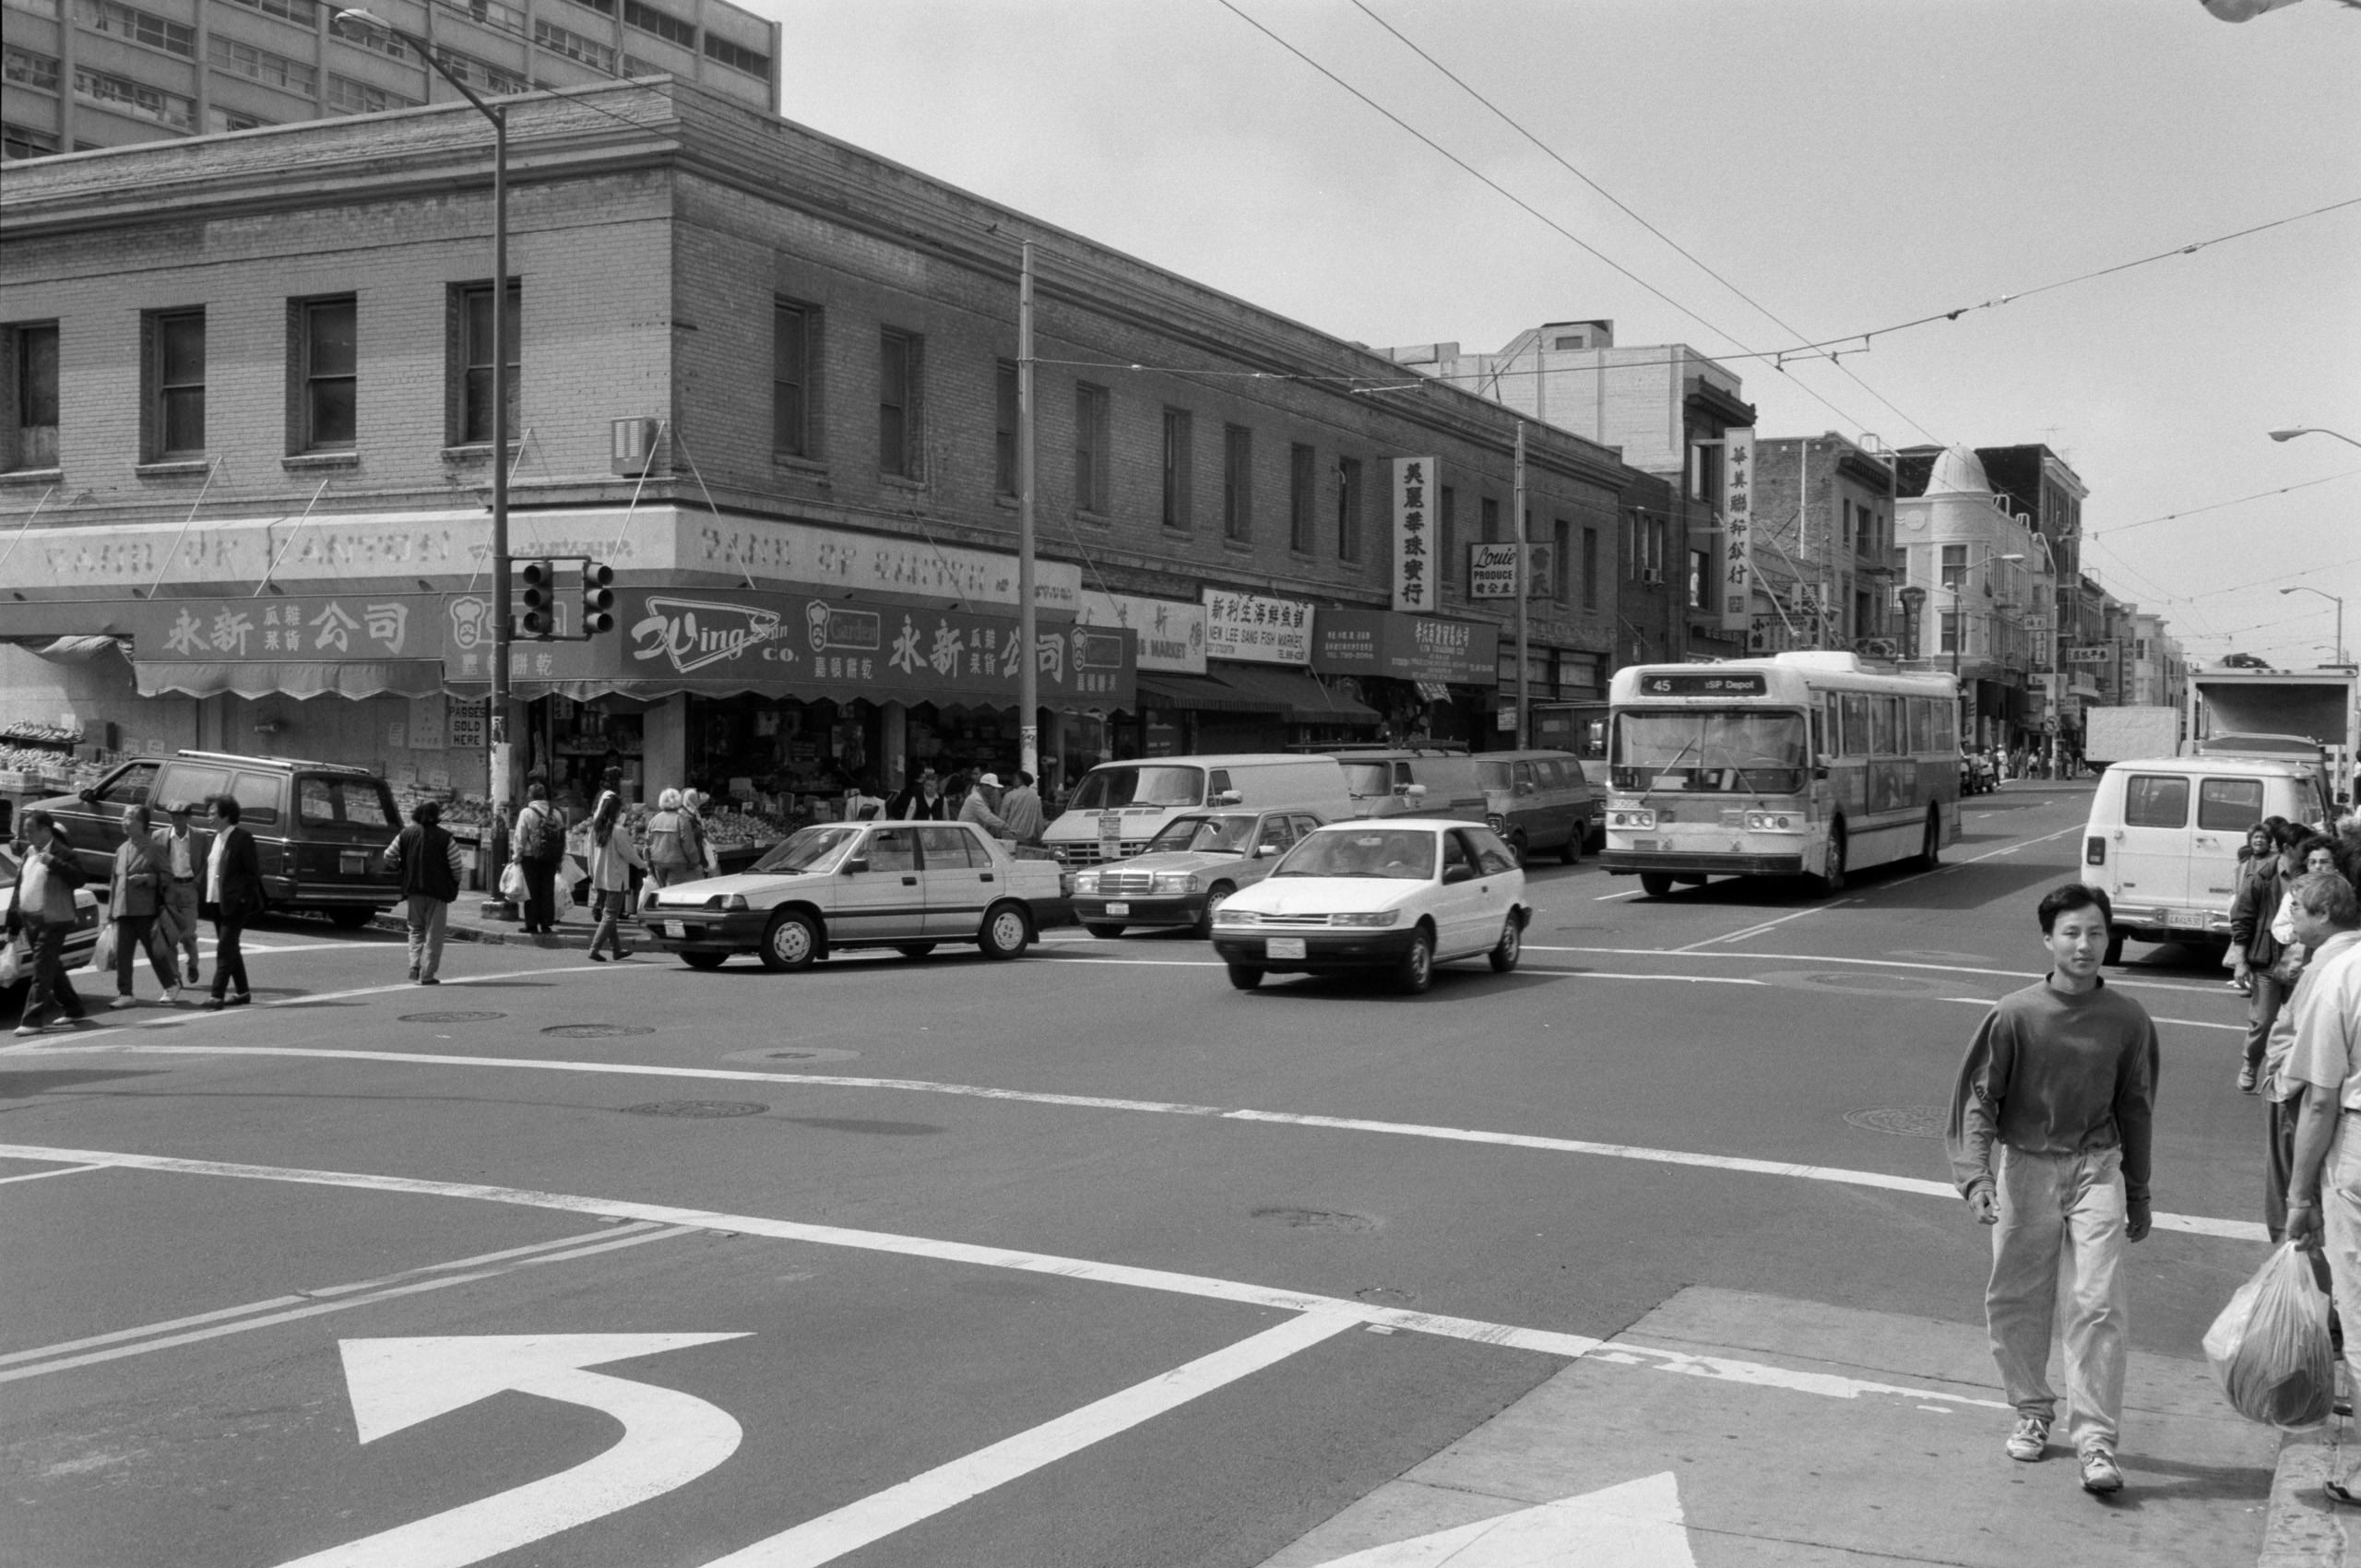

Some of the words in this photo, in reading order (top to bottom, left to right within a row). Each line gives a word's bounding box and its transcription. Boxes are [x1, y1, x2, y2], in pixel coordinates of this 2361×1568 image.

[1473, 546, 1515, 568] Louie
[1473, 569, 1513, 581] PRODUCE
[161, 605, 255, 656] 永新
[308, 600, 408, 655] 公司
[888, 613, 965, 679] 永新
[1150, 639, 1186, 659] MARKET
[1653, 680, 1671, 692] 45
[1725, 680, 1755, 691] Depot
[449, 707, 485, 718] PASSES
[454, 720, 481, 731] SOLD
[454, 734, 481, 745] HERE
